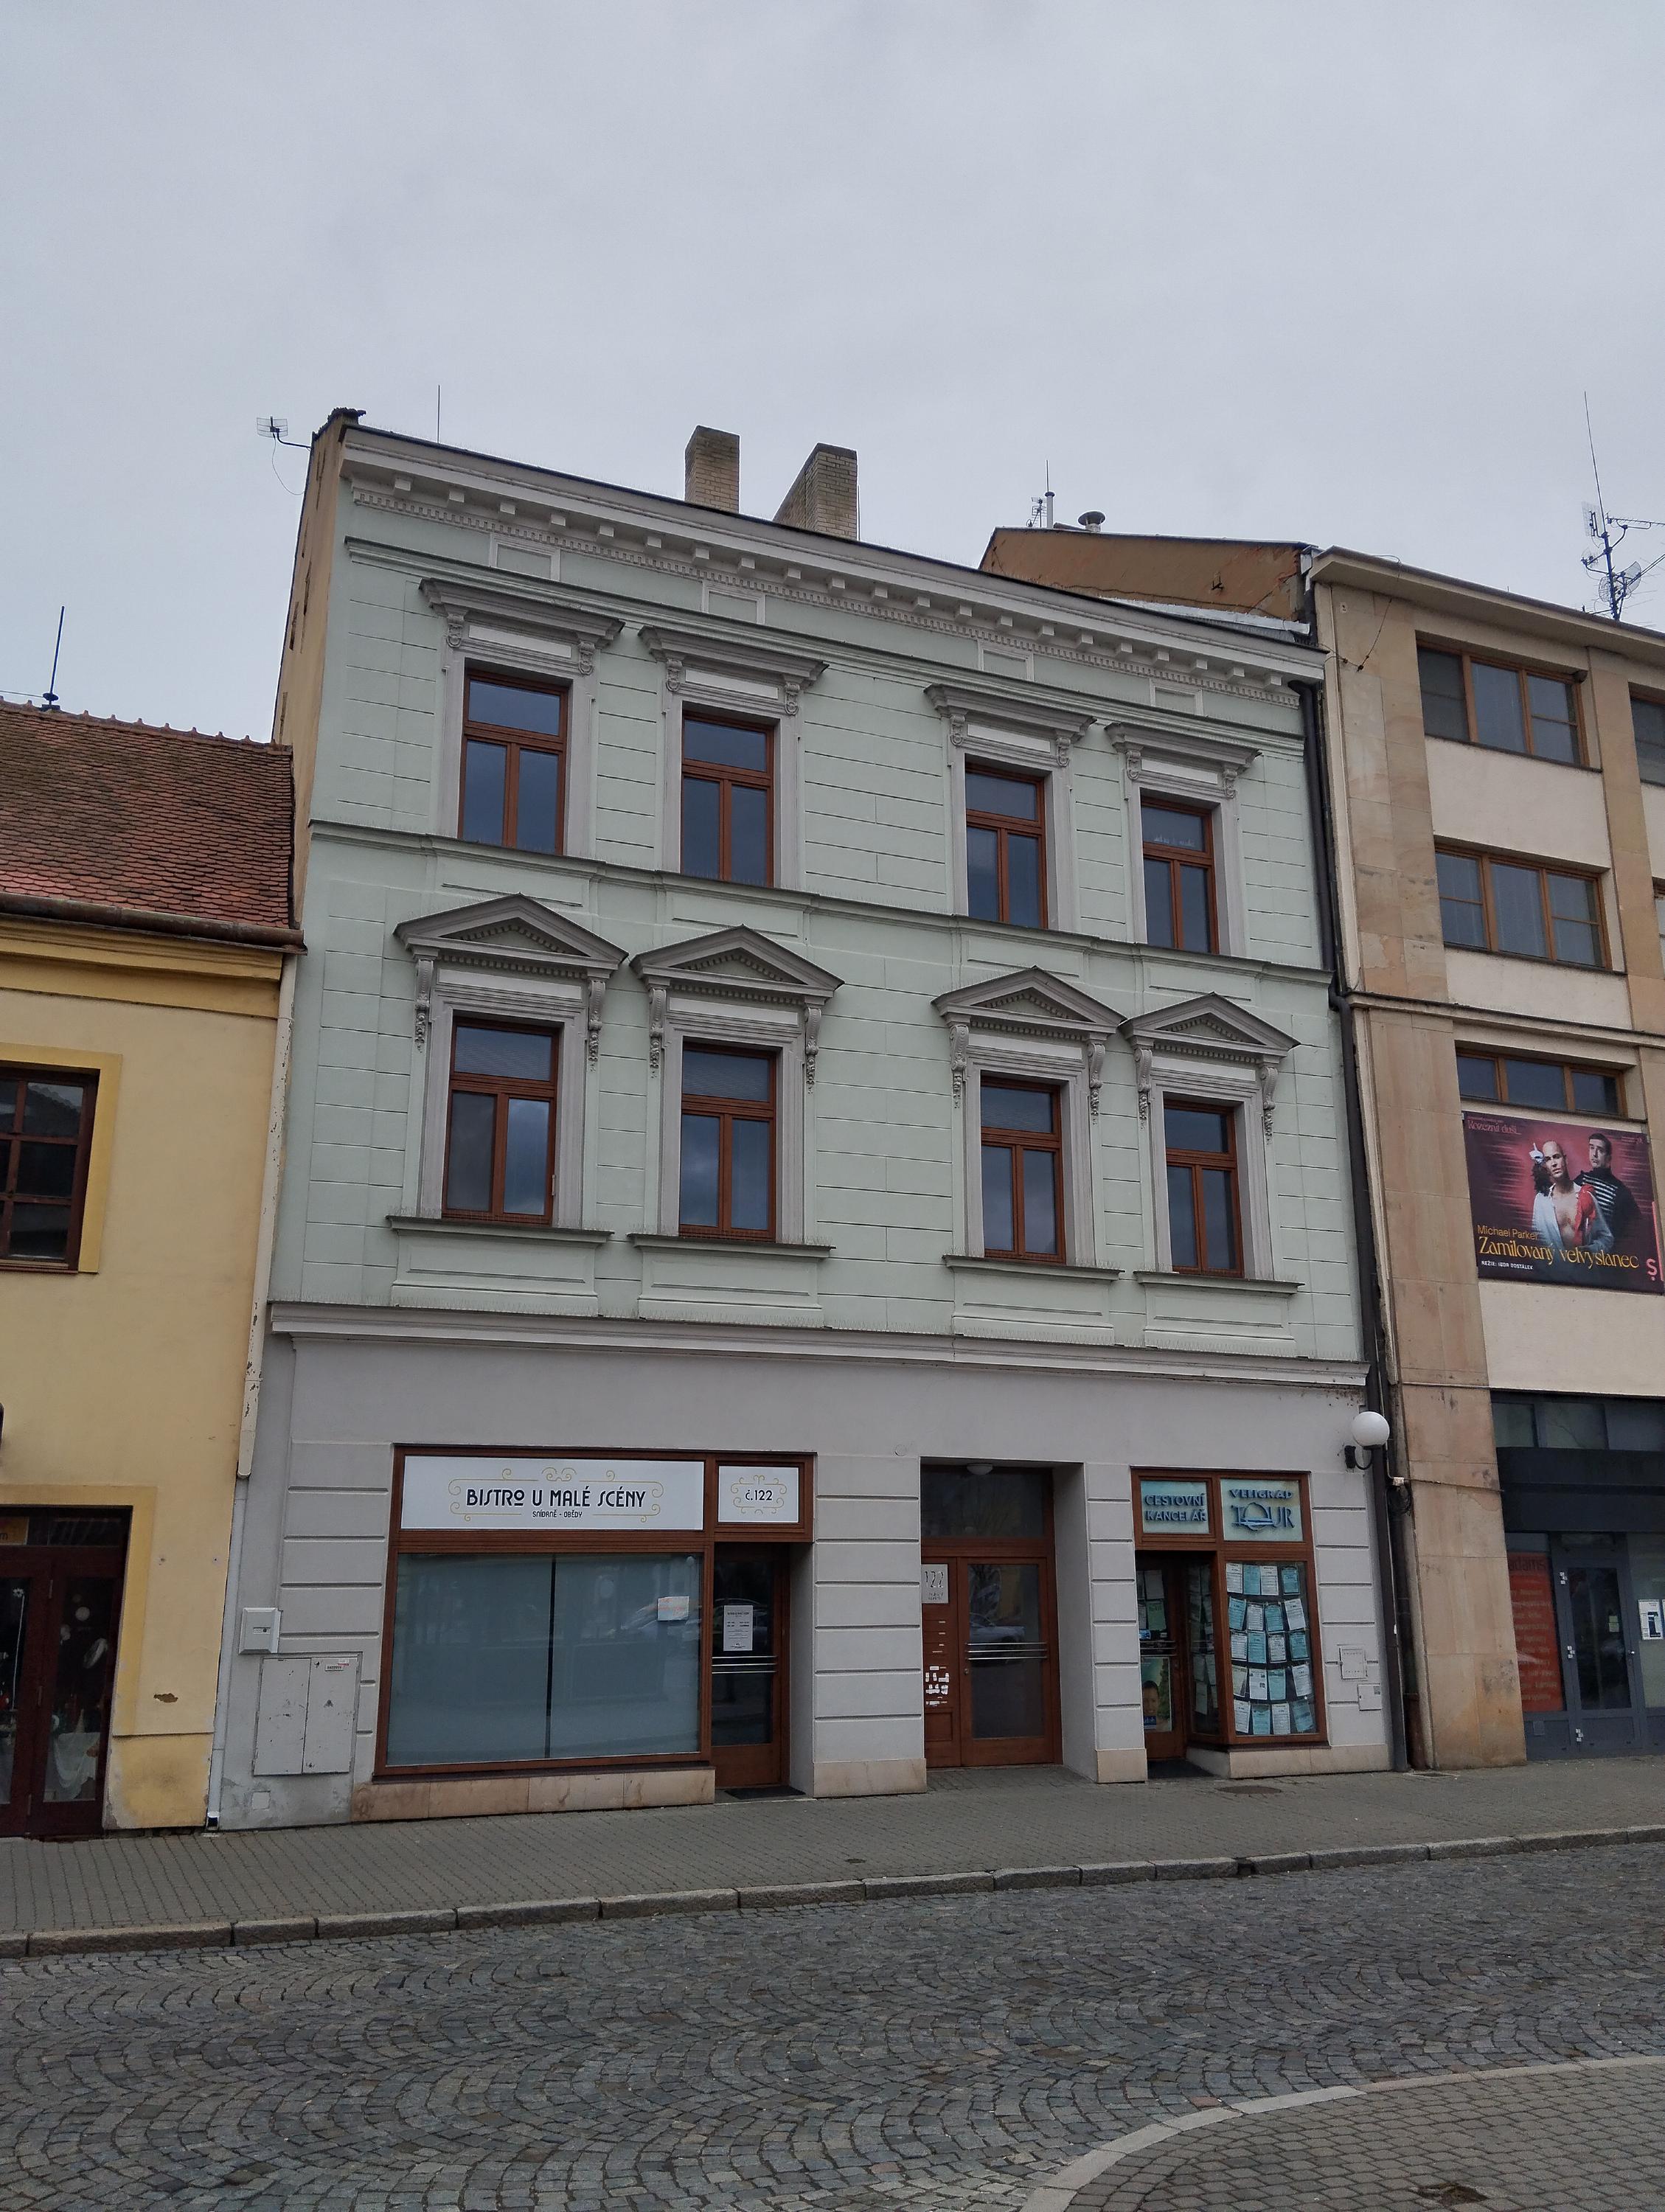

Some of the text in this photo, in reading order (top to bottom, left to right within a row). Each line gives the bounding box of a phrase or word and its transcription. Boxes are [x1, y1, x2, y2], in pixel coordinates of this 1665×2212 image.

[1477, 1225, 1539, 1240] Michael Parker
[1478, 1236, 1640, 1270] Zamilovaný velvyslanec
[466, 1485, 647, 1508] BISTRO U MALÉ SCÉNY
[1145, 1493, 1206, 1506] CESTOVNÍ
[1229, 1489, 1293, 1499] VELIGRAD
[1231, 1501, 1296, 1531] TOUR
